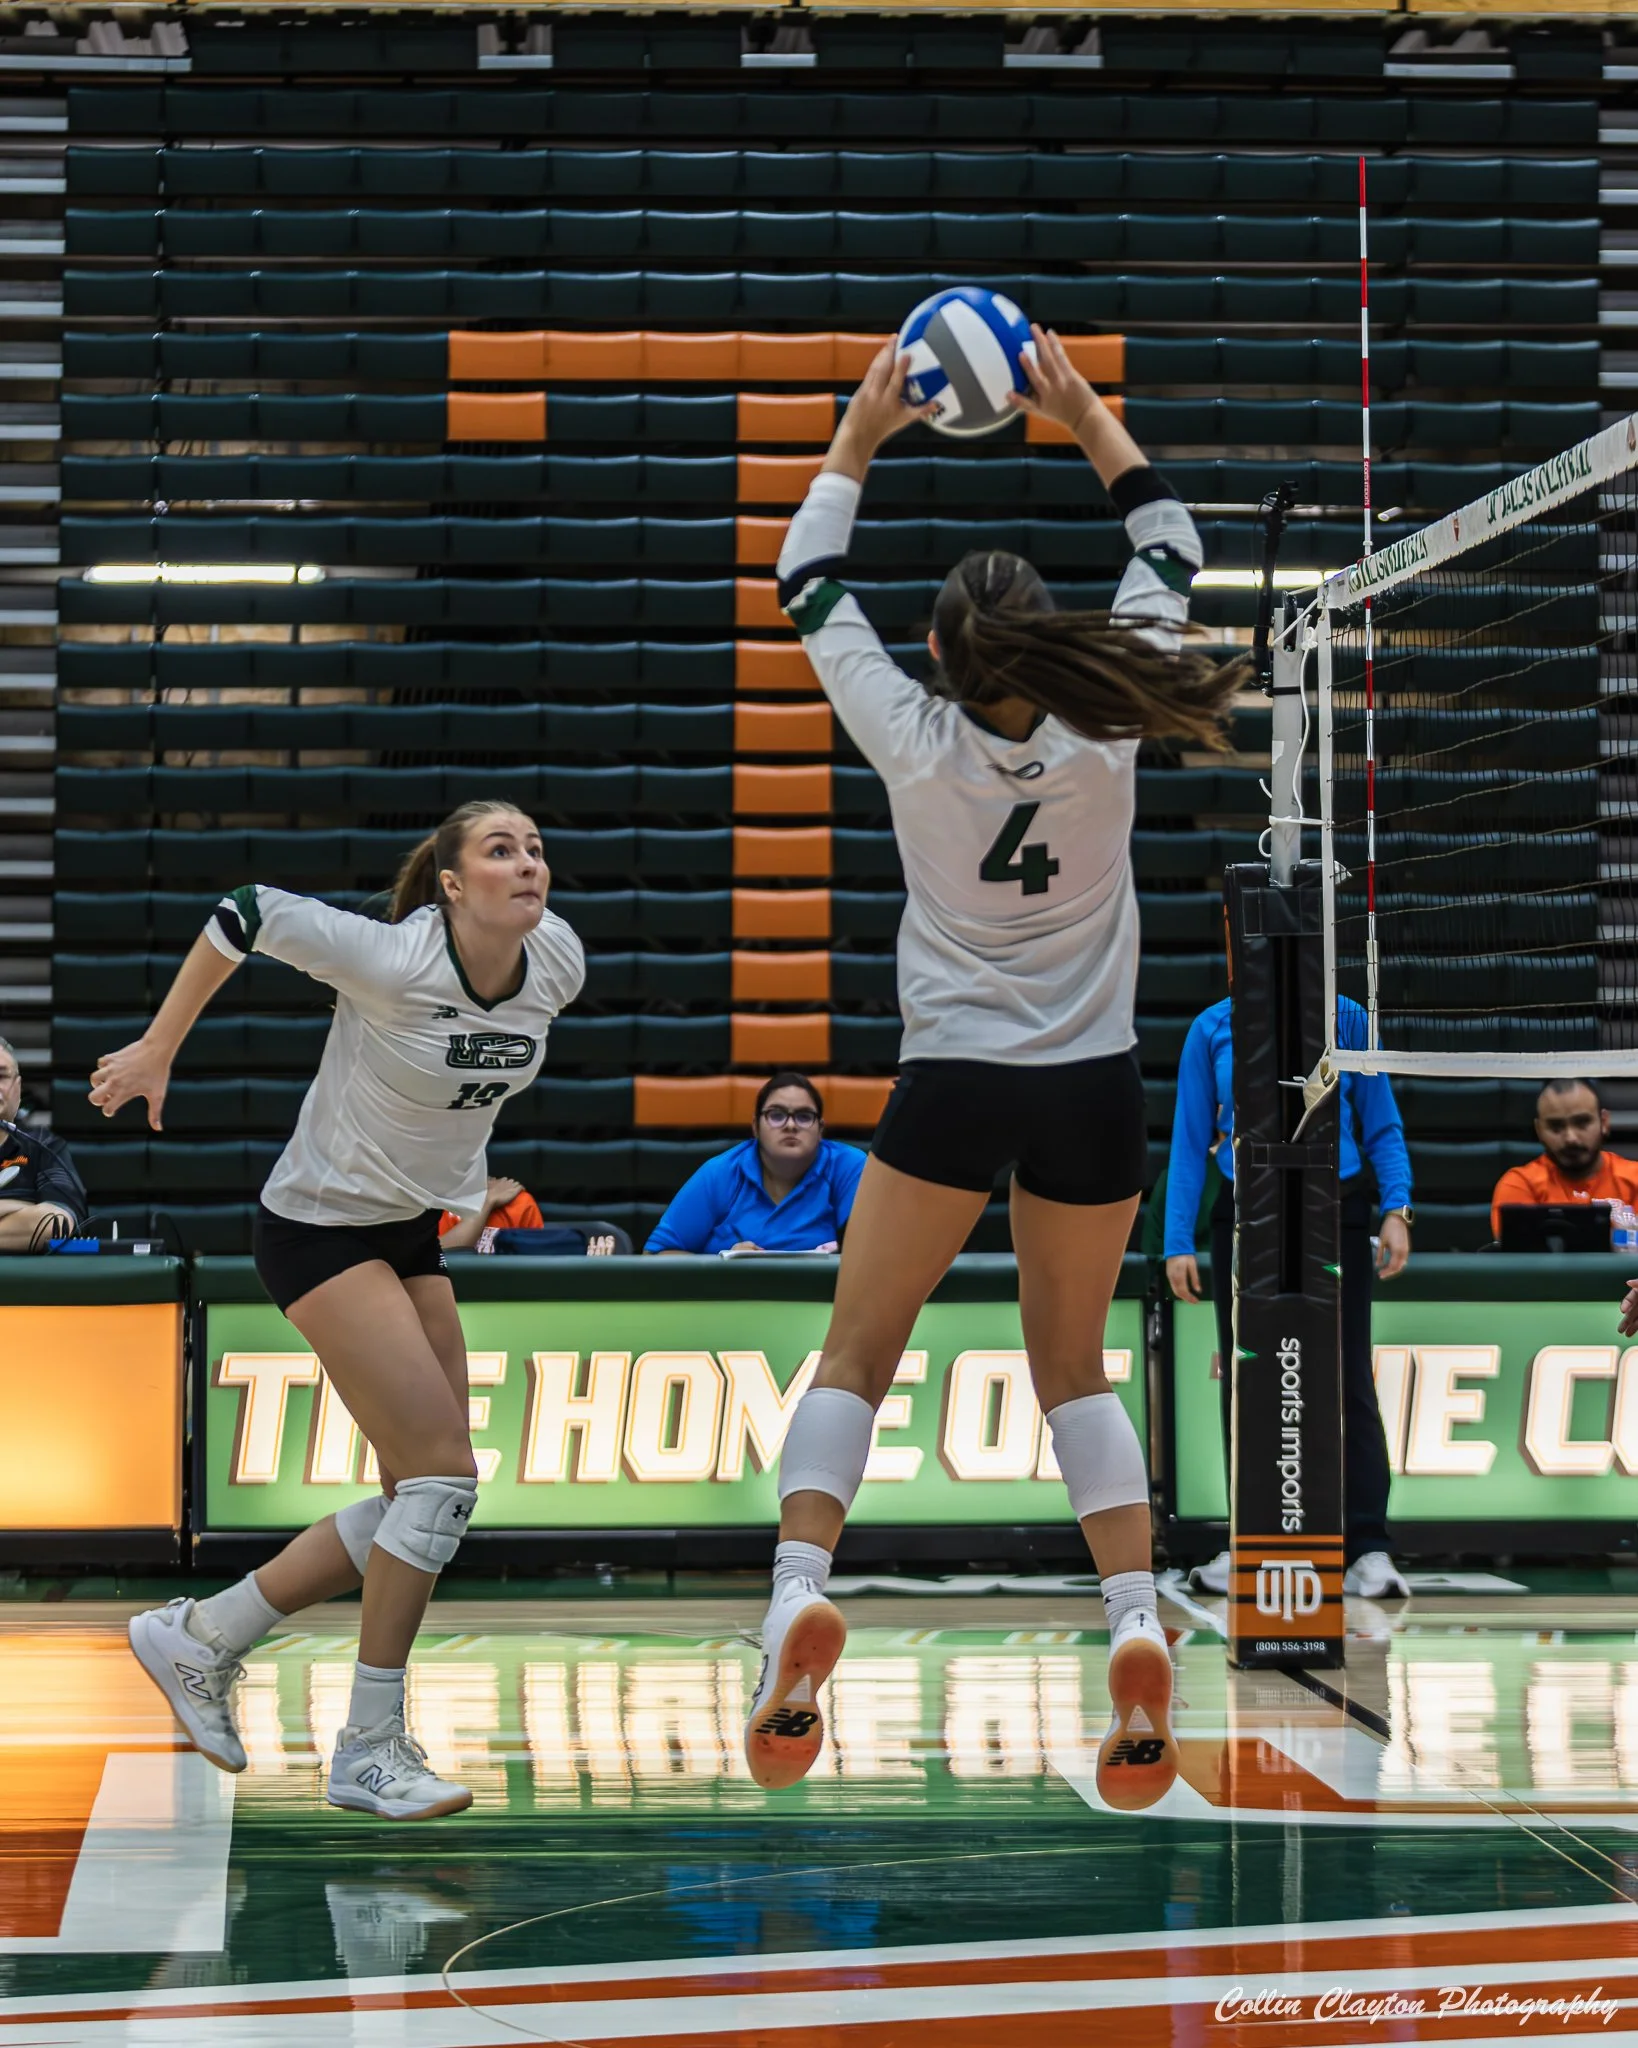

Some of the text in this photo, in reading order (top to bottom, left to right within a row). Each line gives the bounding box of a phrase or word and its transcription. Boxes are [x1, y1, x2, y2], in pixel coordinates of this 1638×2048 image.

[980, 801, 1059, 895] 4
[1276, 1337, 1304, 1533] sports imports
[1525, 1345, 1638, 1476] C
[1256, 1560, 1322, 1622] UTD
[1255, 1641, 1326, 1653] (800) 556-3198
